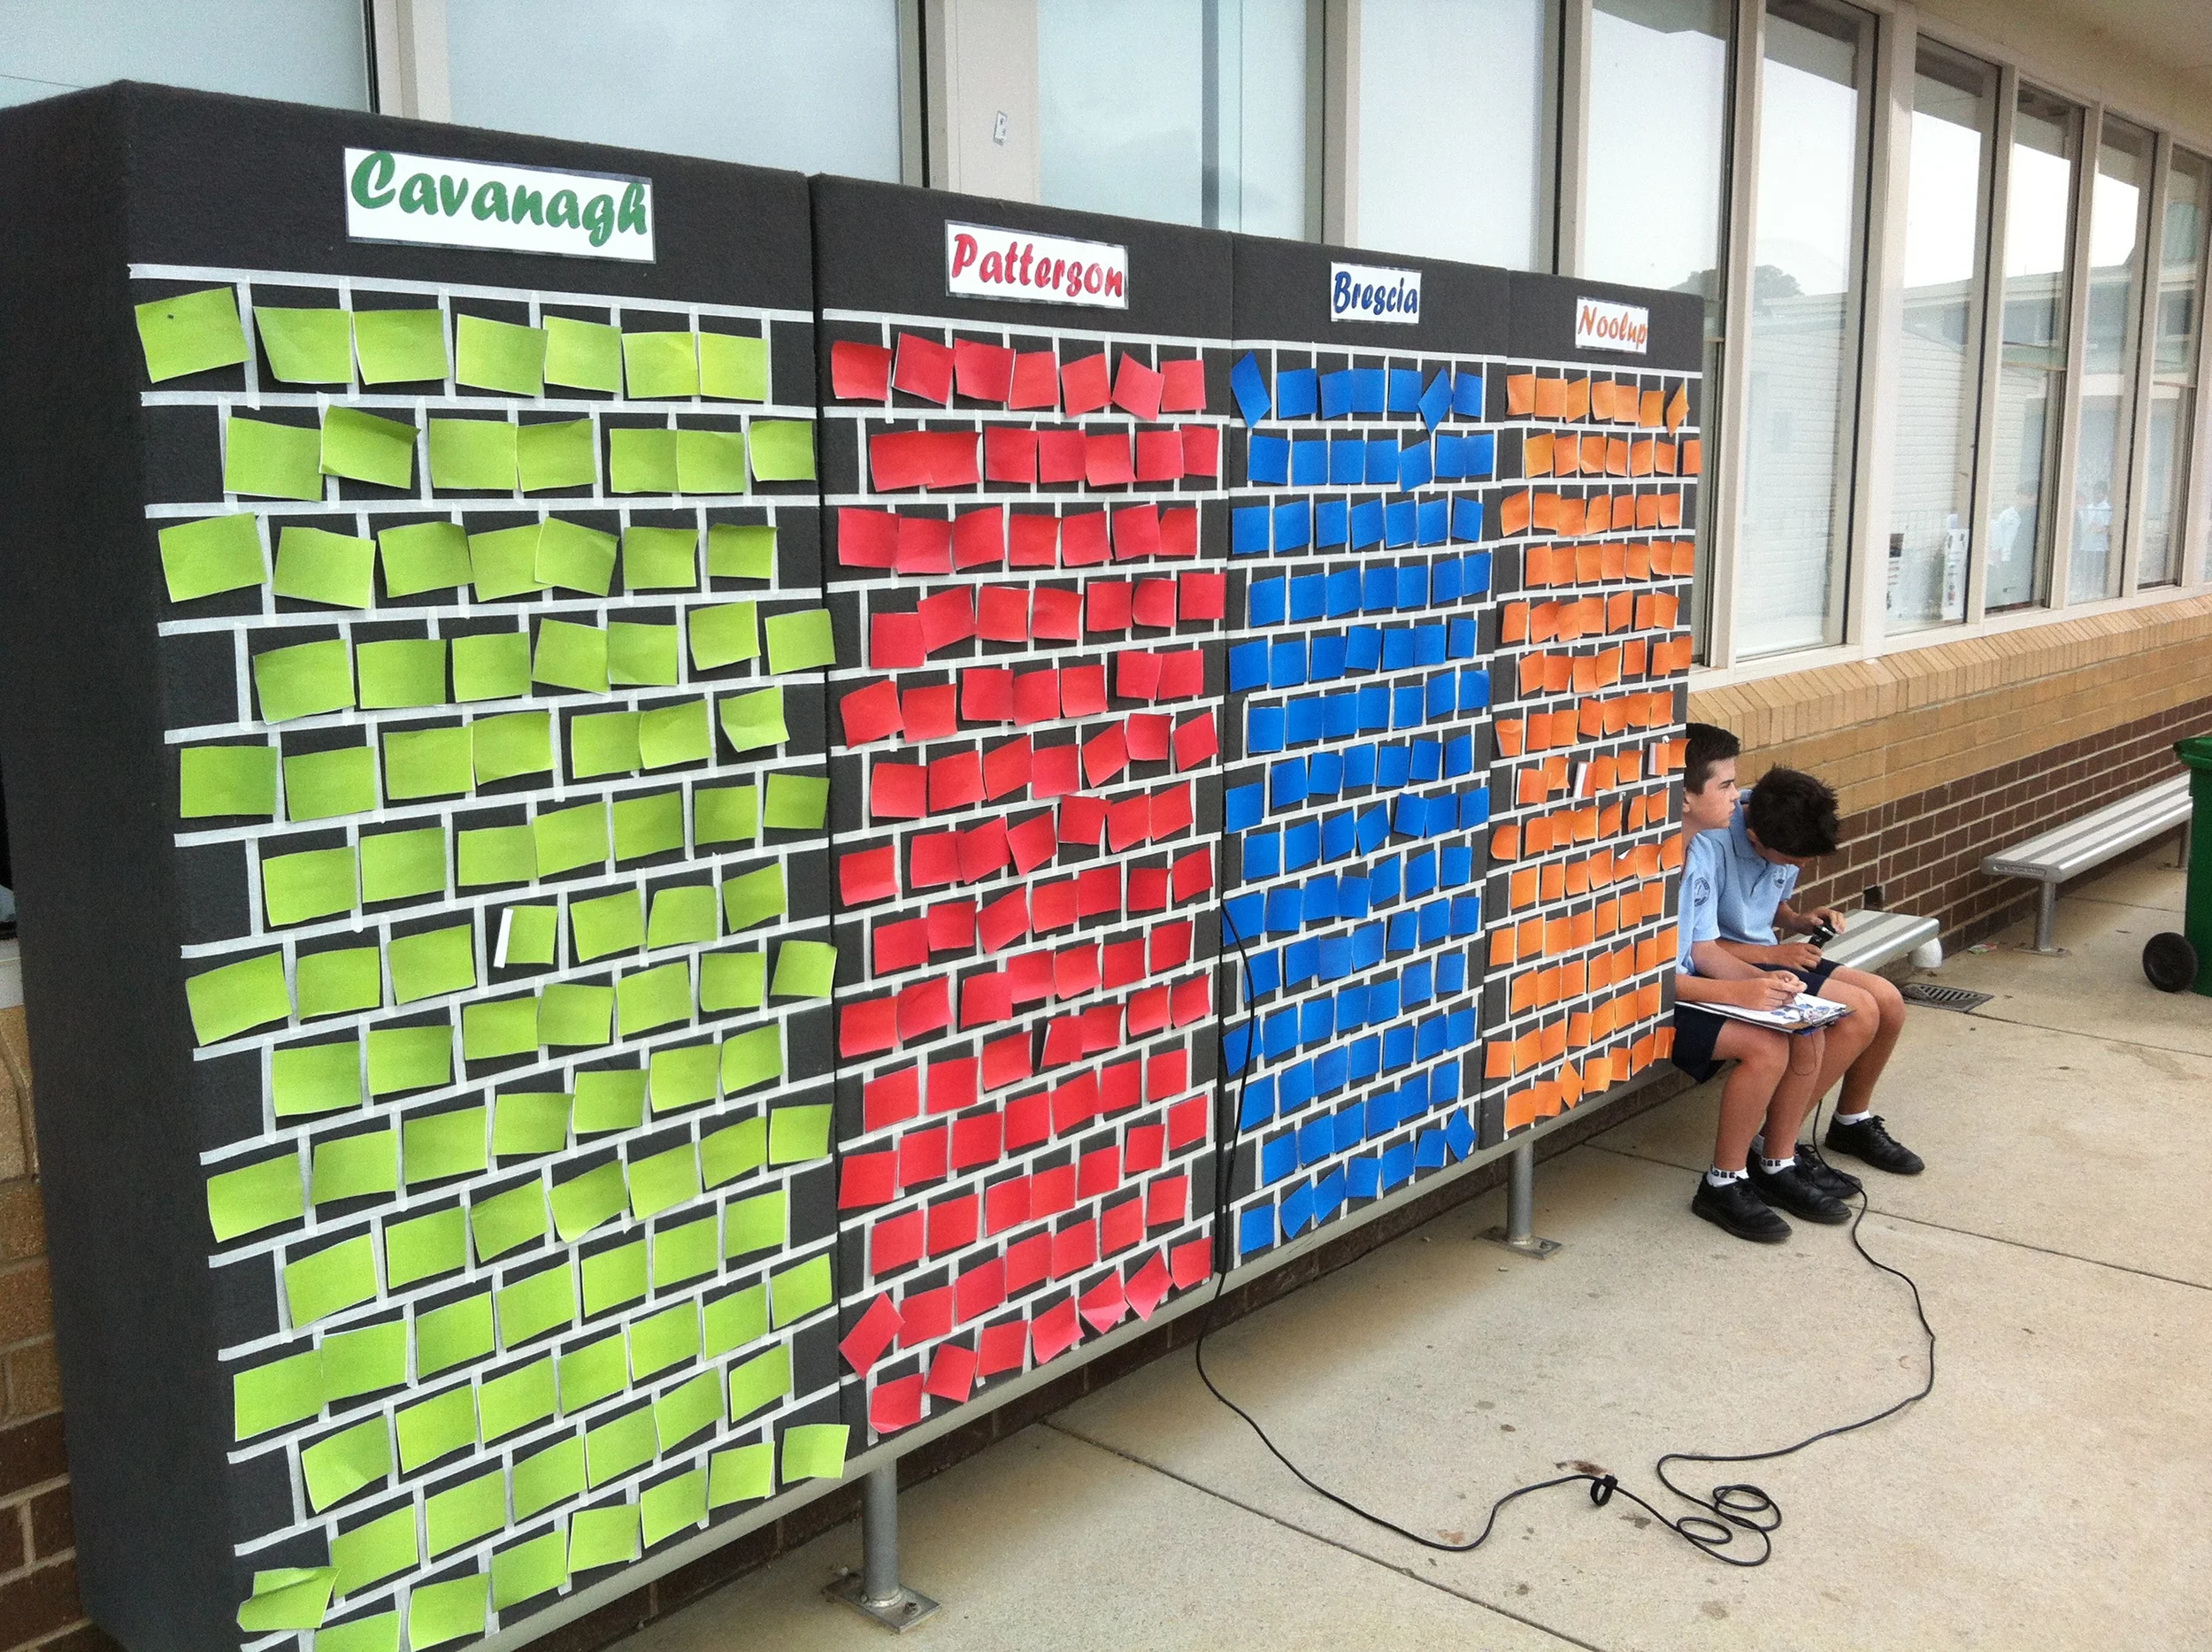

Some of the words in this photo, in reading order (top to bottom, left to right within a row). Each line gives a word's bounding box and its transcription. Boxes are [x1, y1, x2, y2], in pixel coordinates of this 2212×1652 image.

[350, 150, 648, 247] Cavanagh
[951, 233, 1124, 297] Patterson
[1333, 271, 1418, 315] Brescia
[1578, 304, 1647, 350] Noolup
